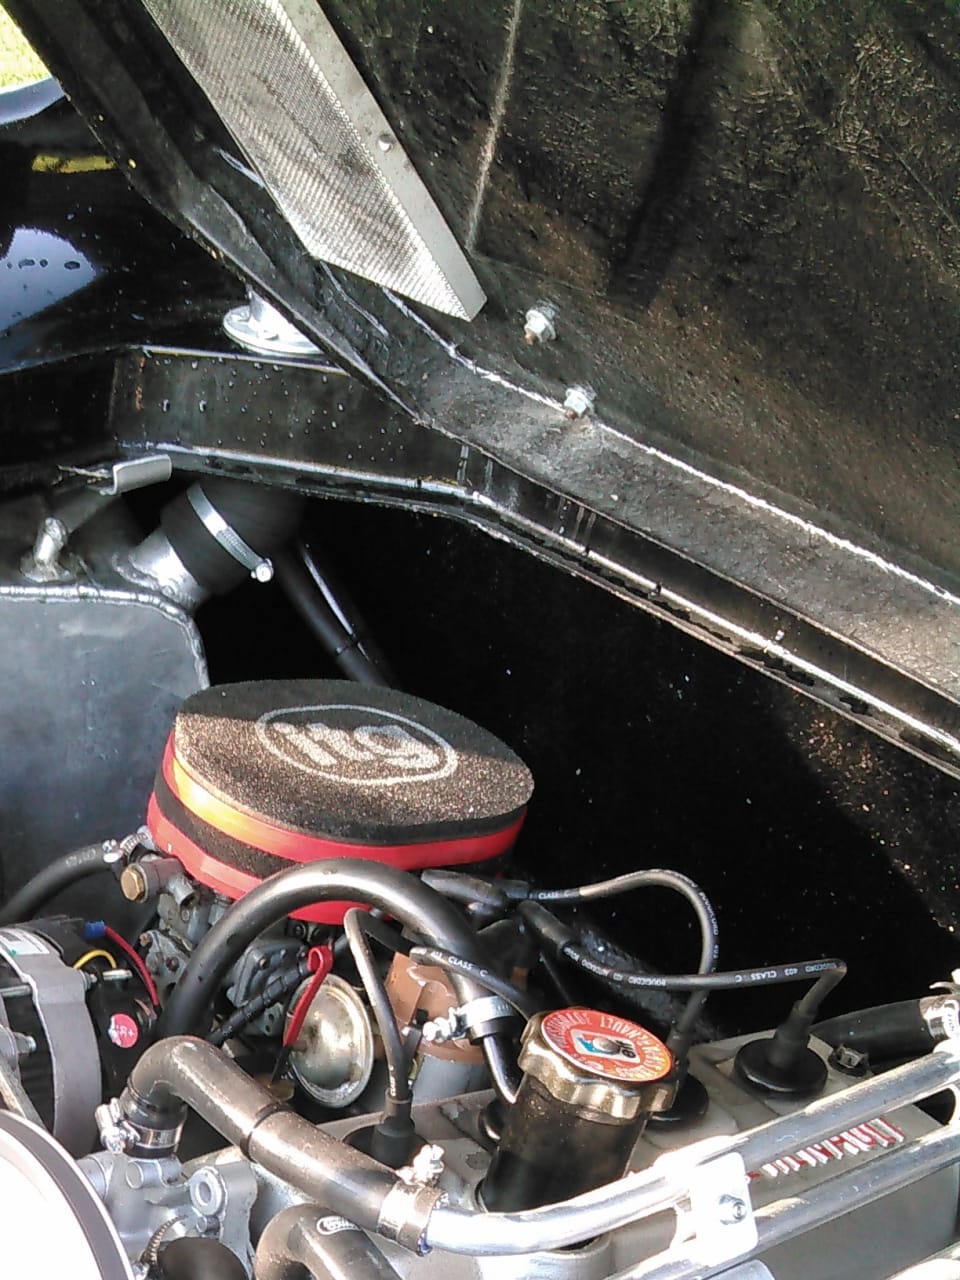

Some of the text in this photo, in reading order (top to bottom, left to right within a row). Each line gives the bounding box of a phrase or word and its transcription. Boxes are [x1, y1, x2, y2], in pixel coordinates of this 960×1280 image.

[447, 955, 476, 971] CLASS
[479, 969, 489, 978] C
[735, 974, 742, 983] C
[750, 969, 777, 980] CLASS
